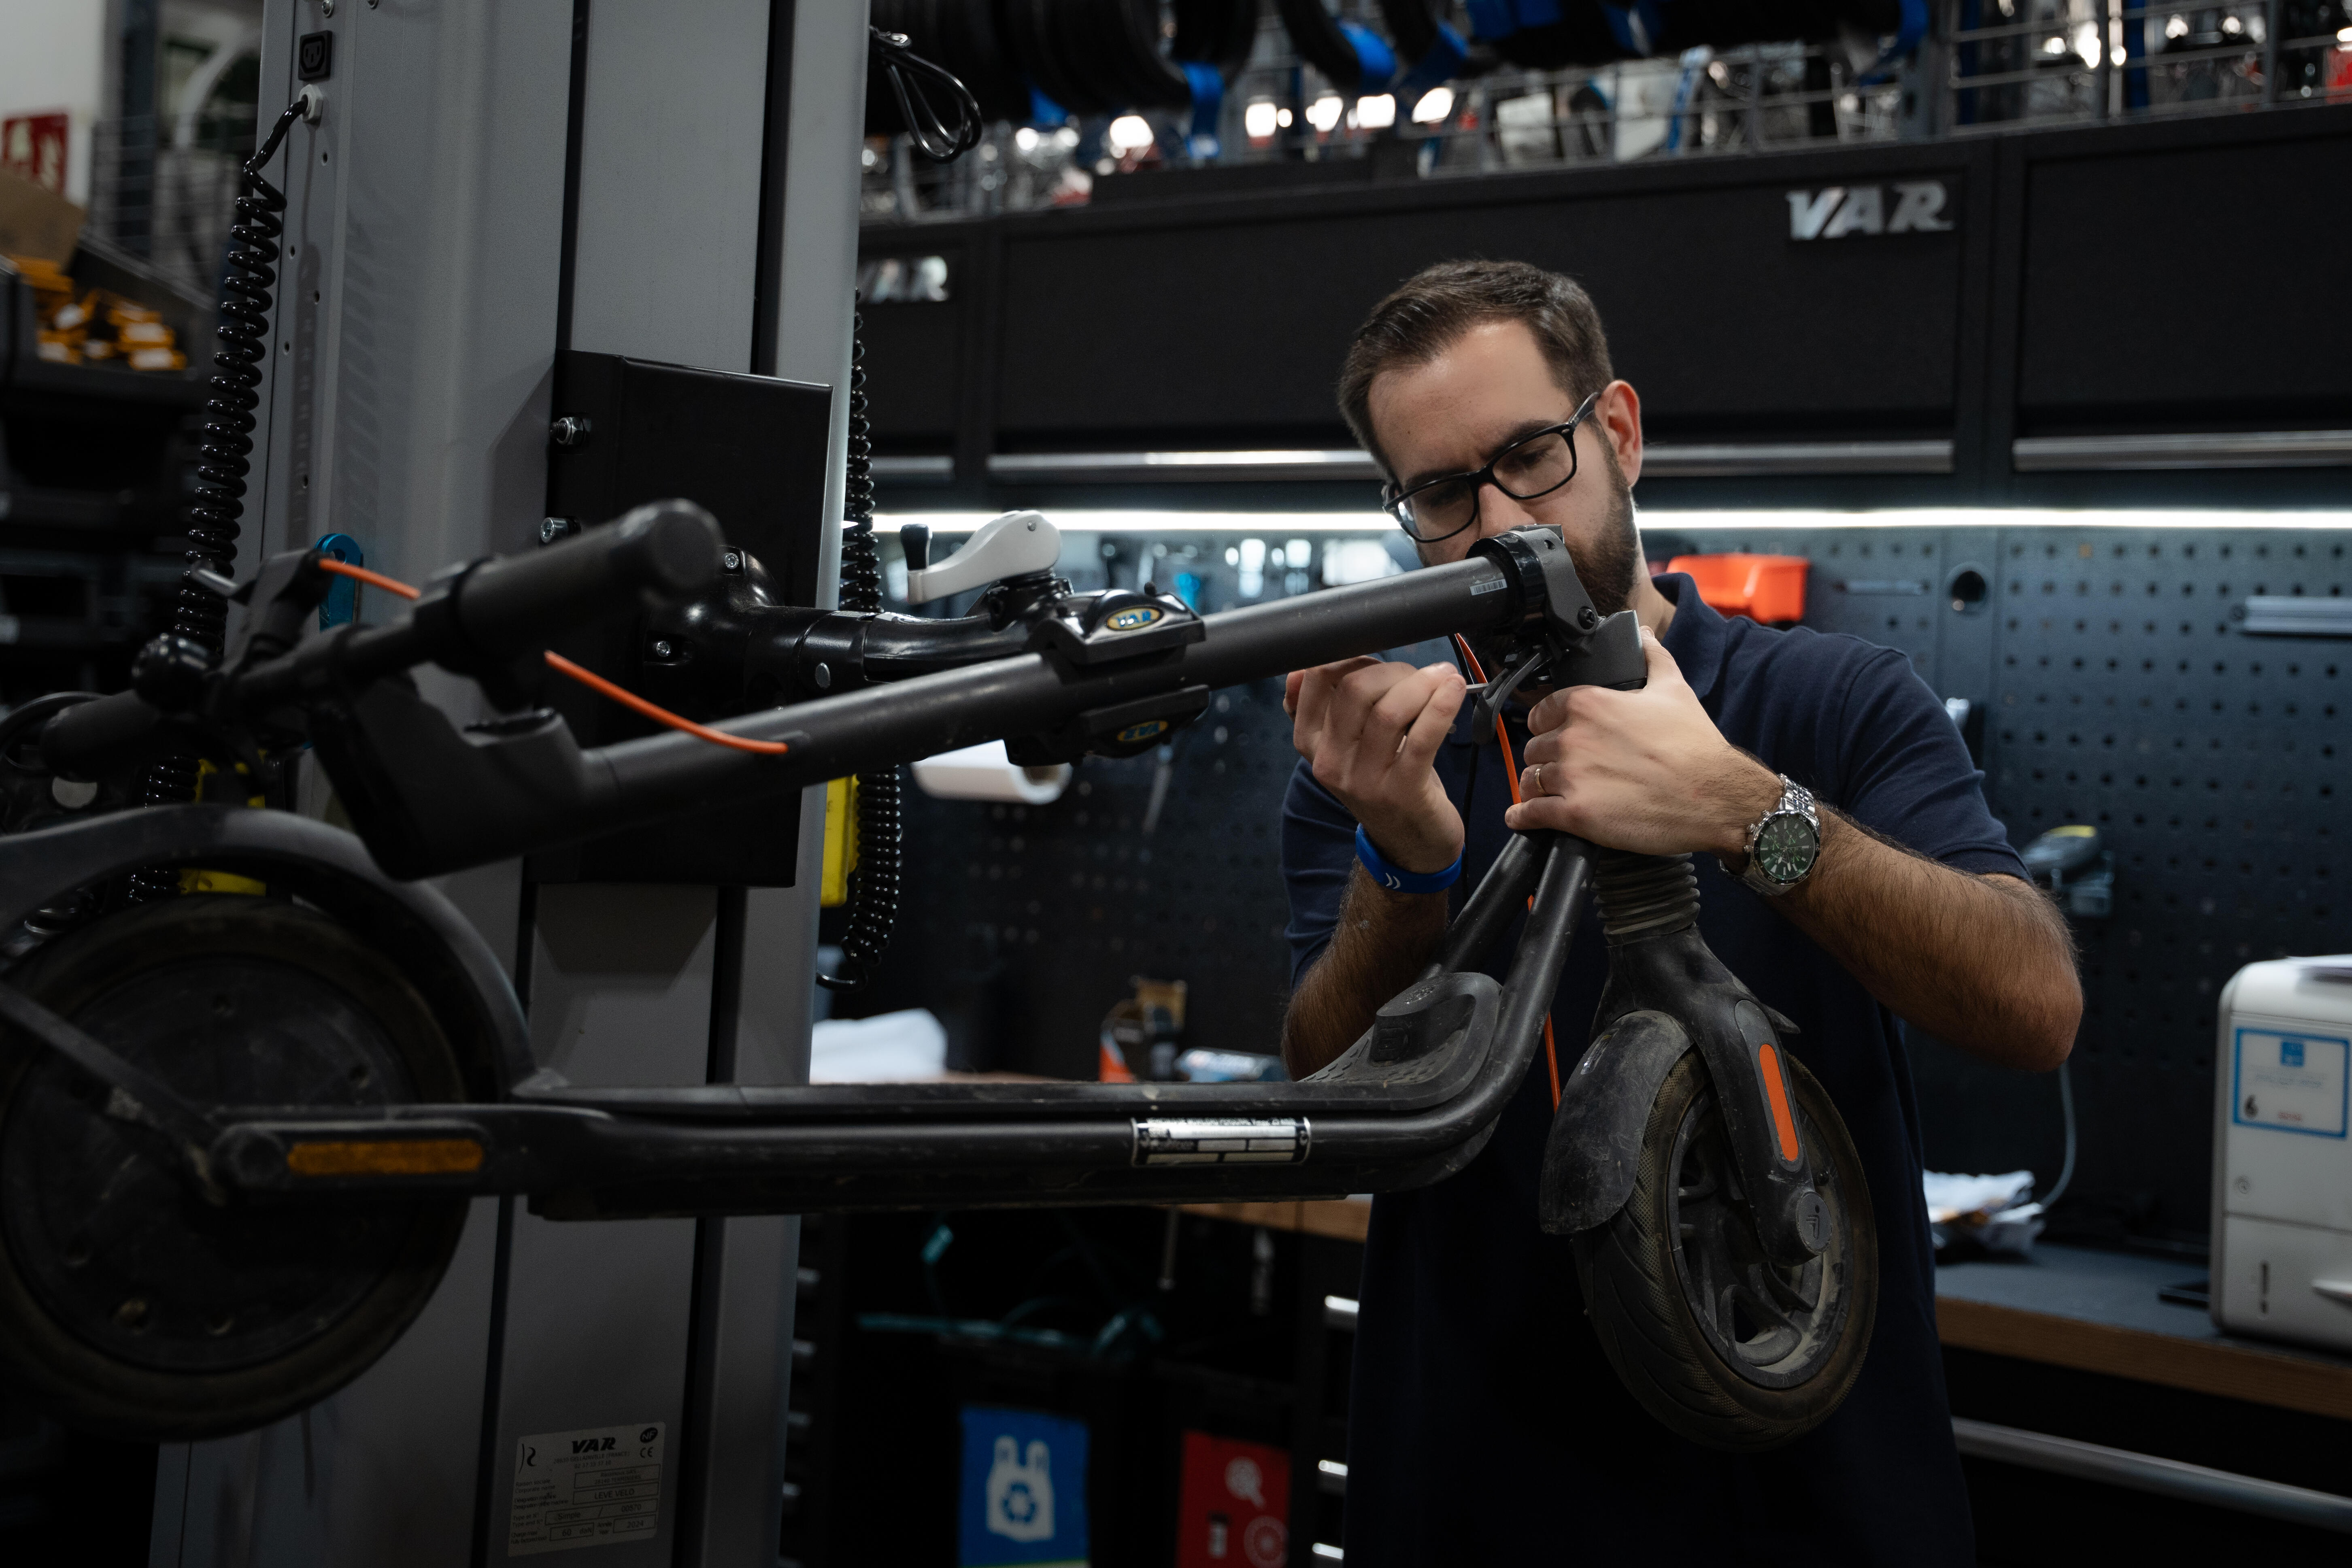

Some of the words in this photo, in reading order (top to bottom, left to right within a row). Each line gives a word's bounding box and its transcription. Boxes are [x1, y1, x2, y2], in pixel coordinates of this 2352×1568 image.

[1785, 179, 1956, 241] VAR
[1116, 610, 1151, 627] VAR
[642, 1429, 656, 1441] NF
[571, 1437, 616, 1454] VAR
[640, 1447, 654, 1458] CE
[594, 1491, 613, 1500] LEVE
[615, 1488, 635, 1498] VELO
[557, 1511, 581, 1521] Simple
[627, 1520, 644, 1529] 2024
[561, 1528, 572, 1536] 60
